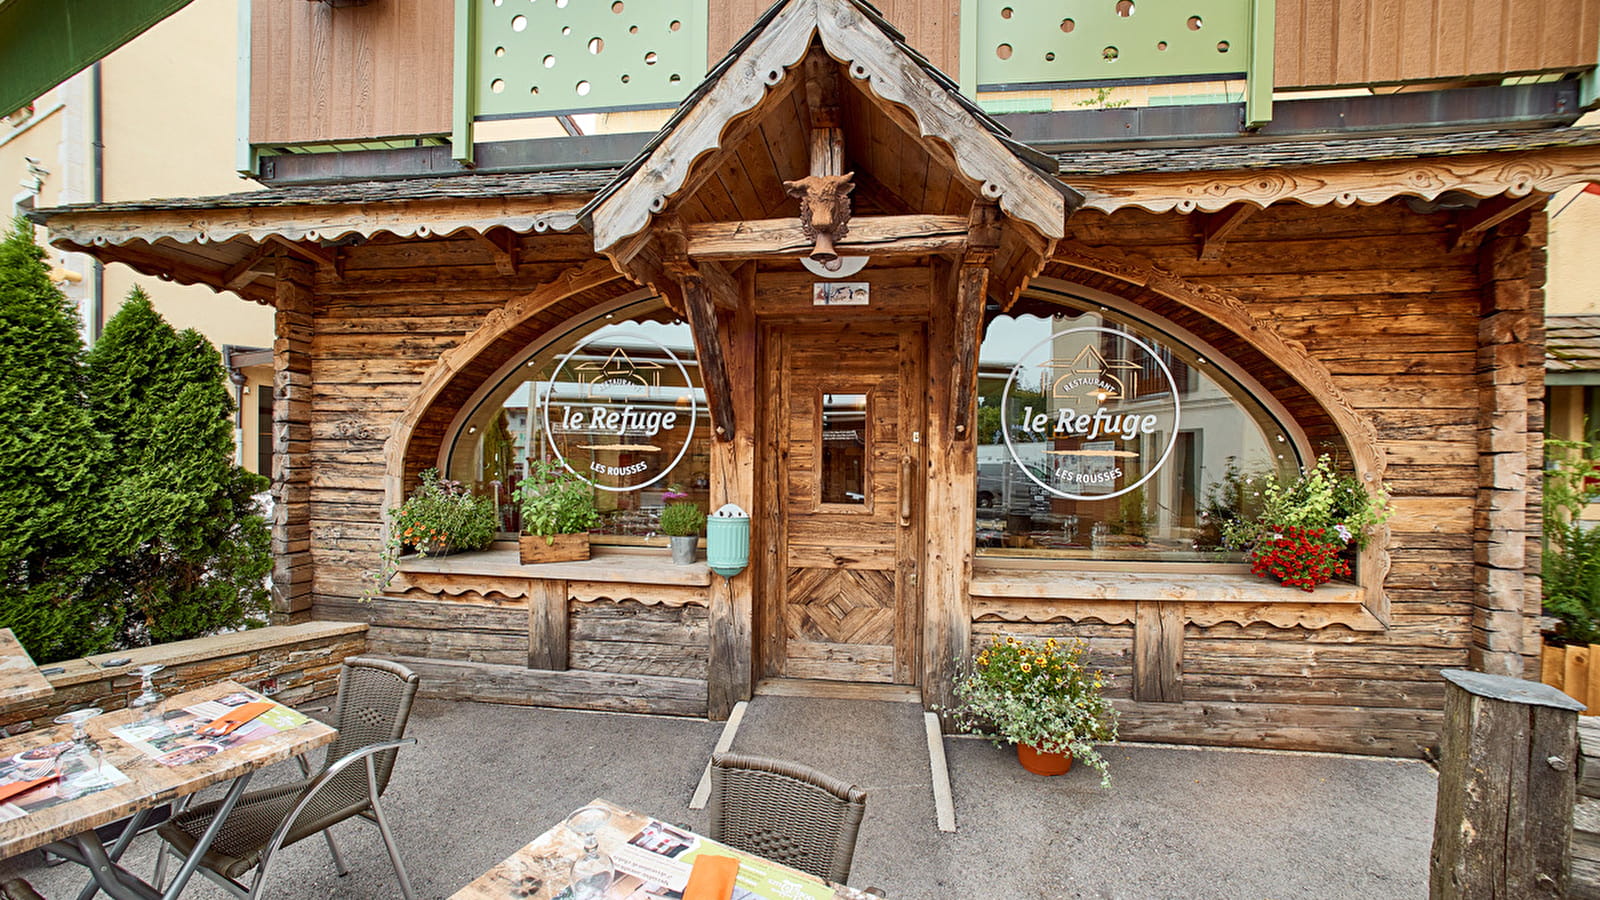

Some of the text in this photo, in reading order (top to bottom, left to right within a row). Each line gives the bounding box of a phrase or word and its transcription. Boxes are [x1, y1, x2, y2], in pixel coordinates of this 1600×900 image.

[1063, 379, 1116, 393] RESTAURANT
[562, 406, 677, 436] le Refuge
[1022, 406, 1158, 440] le Refuge
[590, 461, 648, 476] LES ROUSSES
[1055, 467, 1123, 484] LES ROUSSES
